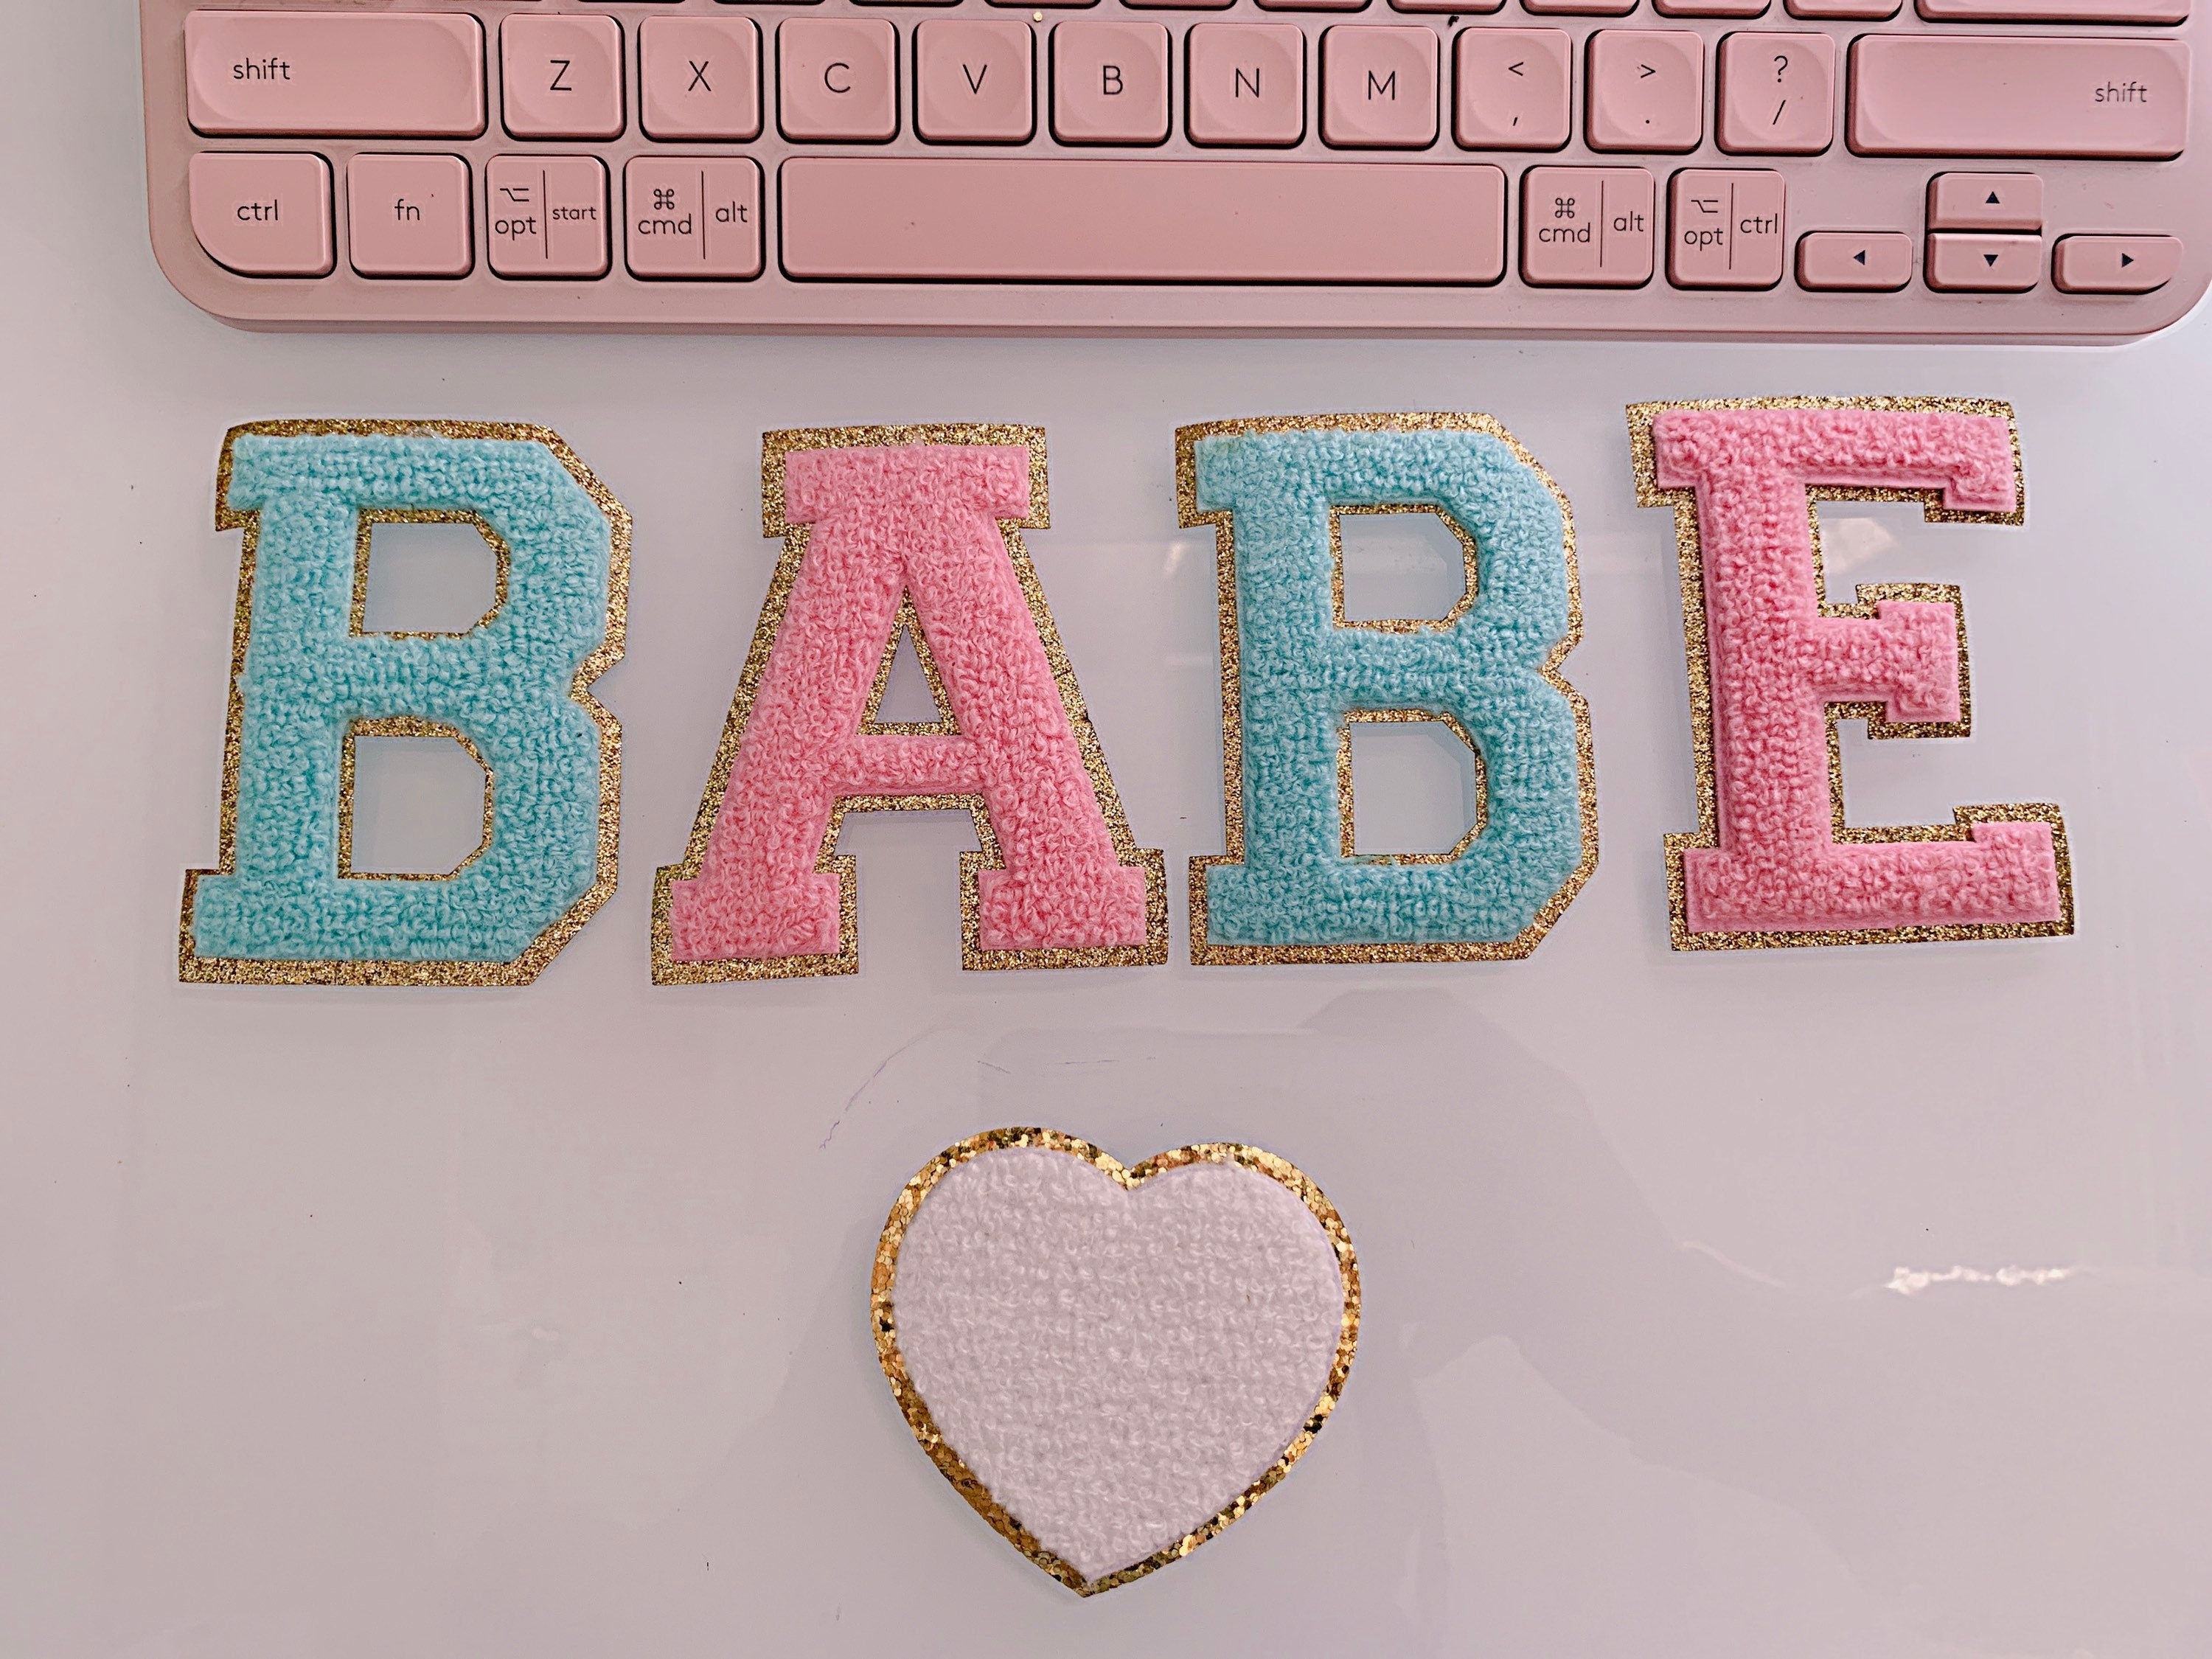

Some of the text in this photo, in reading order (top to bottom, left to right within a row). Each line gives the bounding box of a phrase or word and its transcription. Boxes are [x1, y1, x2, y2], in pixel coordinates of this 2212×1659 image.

[233, 57, 291, 80] shift
[549, 59, 572, 91] Z
[687, 60, 712, 92] X
[824, 62, 852, 94] C
[962, 63, 988, 95] V
[1102, 64, 1124, 96] B
[1235, 67, 1260, 99] N
[1368, 69, 1396, 101] M
[2095, 81, 2148, 103] shift
[237, 198, 279, 221] ctrl
[394, 198, 420, 221] fn
[552, 206, 597, 220] start
[715, 200, 748, 223] alt
[1613, 210, 1644, 232] alt
[494, 216, 537, 239] opt
[638, 212, 692, 235] cmd
[1538, 222, 1591, 243] cmd
[1739, 212, 1778, 234] ctrl
[1683, 227, 1724, 250] opt
